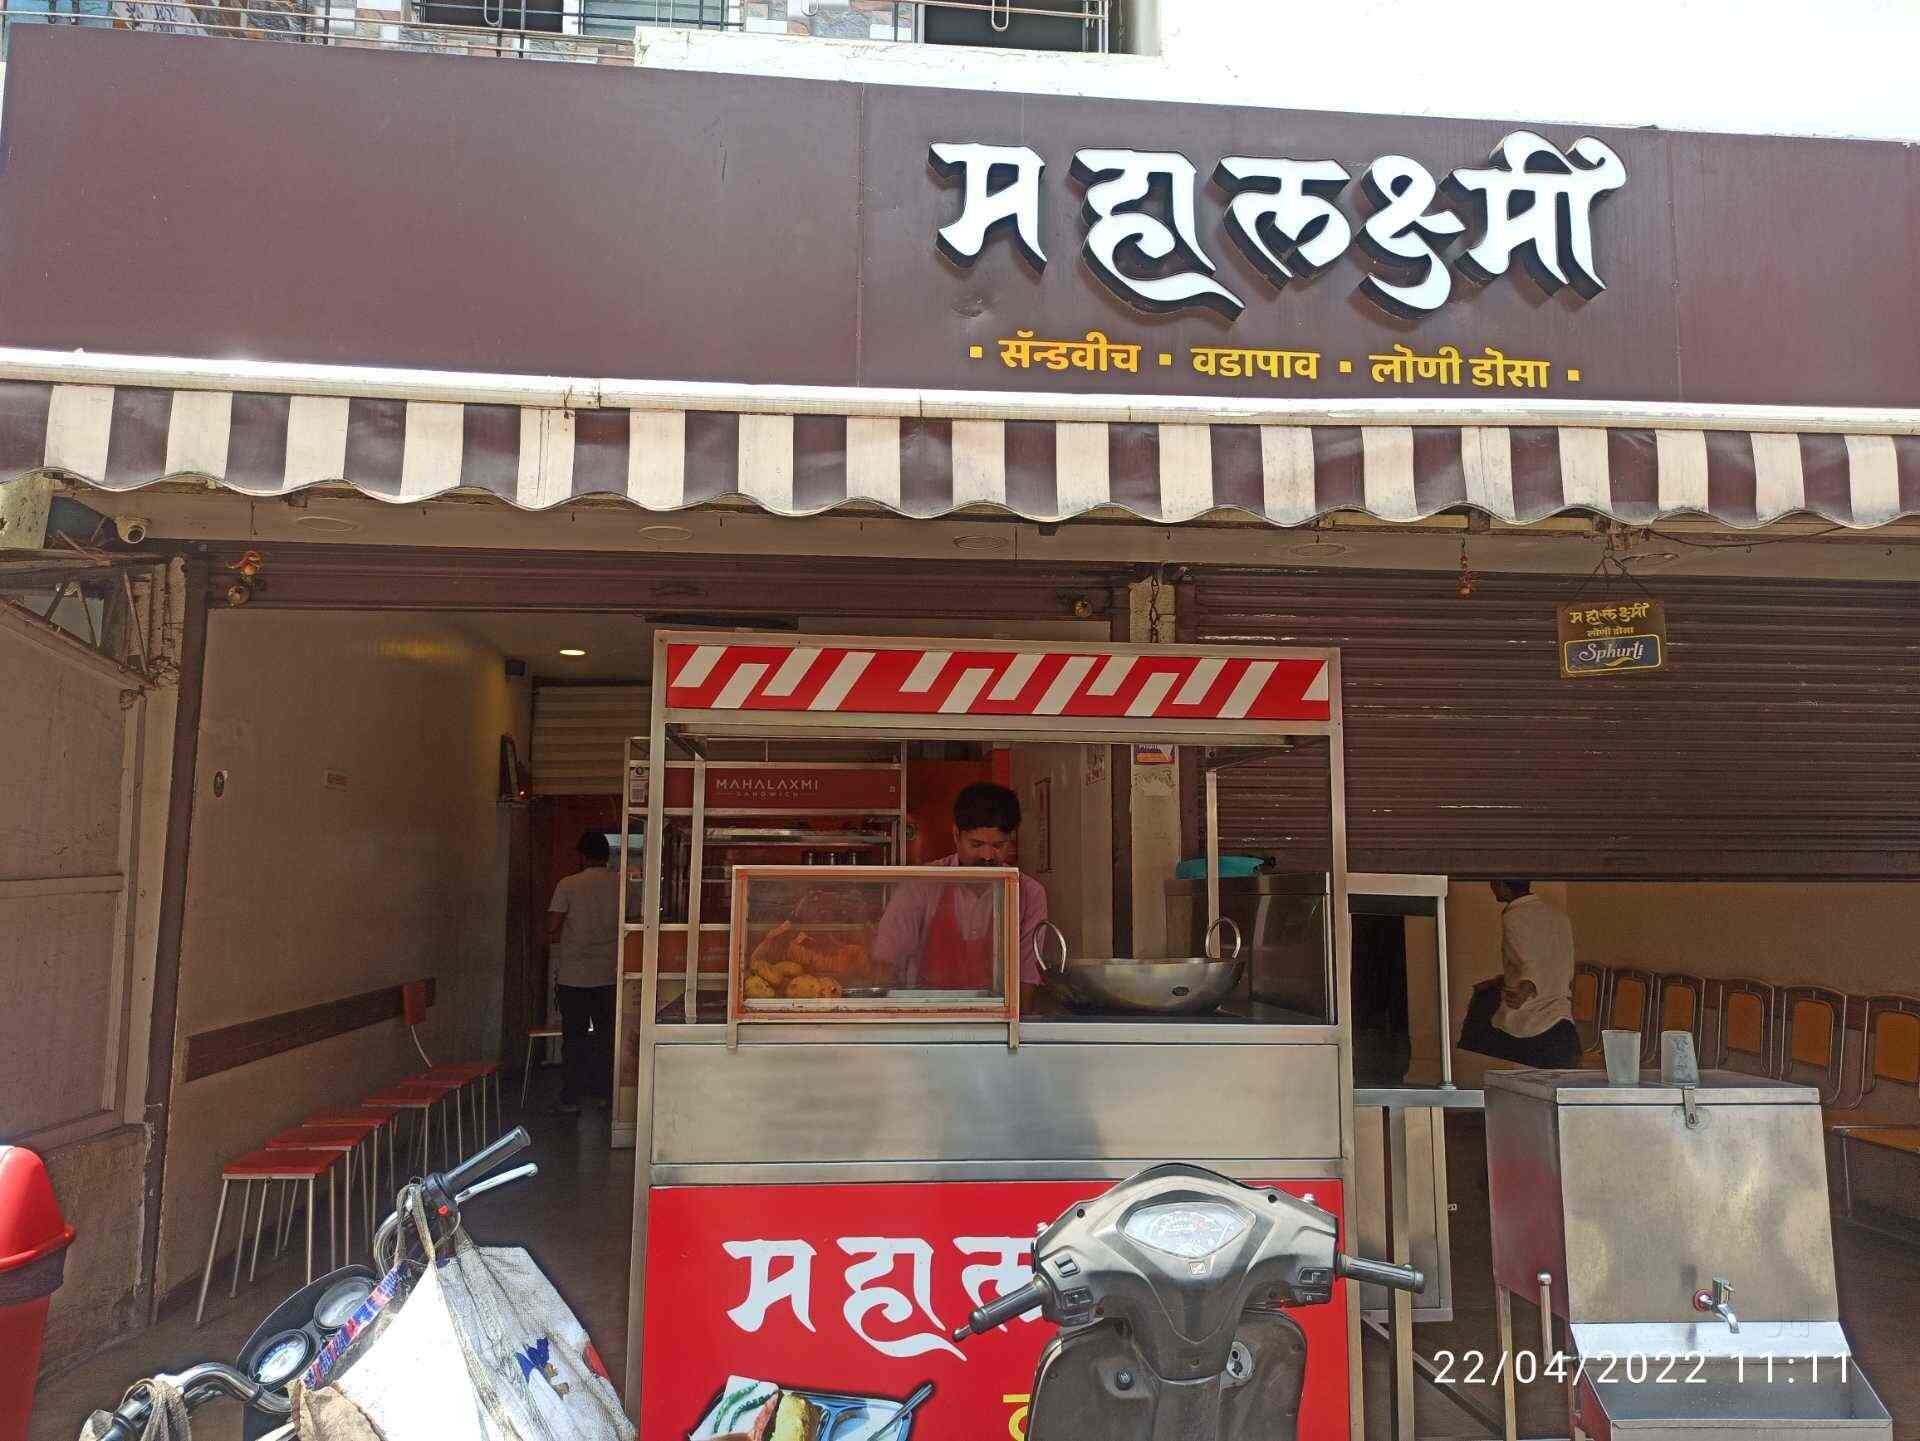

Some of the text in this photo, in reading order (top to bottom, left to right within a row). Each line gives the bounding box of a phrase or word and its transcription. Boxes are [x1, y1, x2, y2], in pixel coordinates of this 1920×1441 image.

[930, 129, 1628, 320] महालक्ष्मी
[998, 330, 1552, 388] सॅन्डवीच वडापाव लोणी डोसा
[1578, 640, 1645, 663] Sphurti
[716, 778, 819, 791] MAHALAXMI
